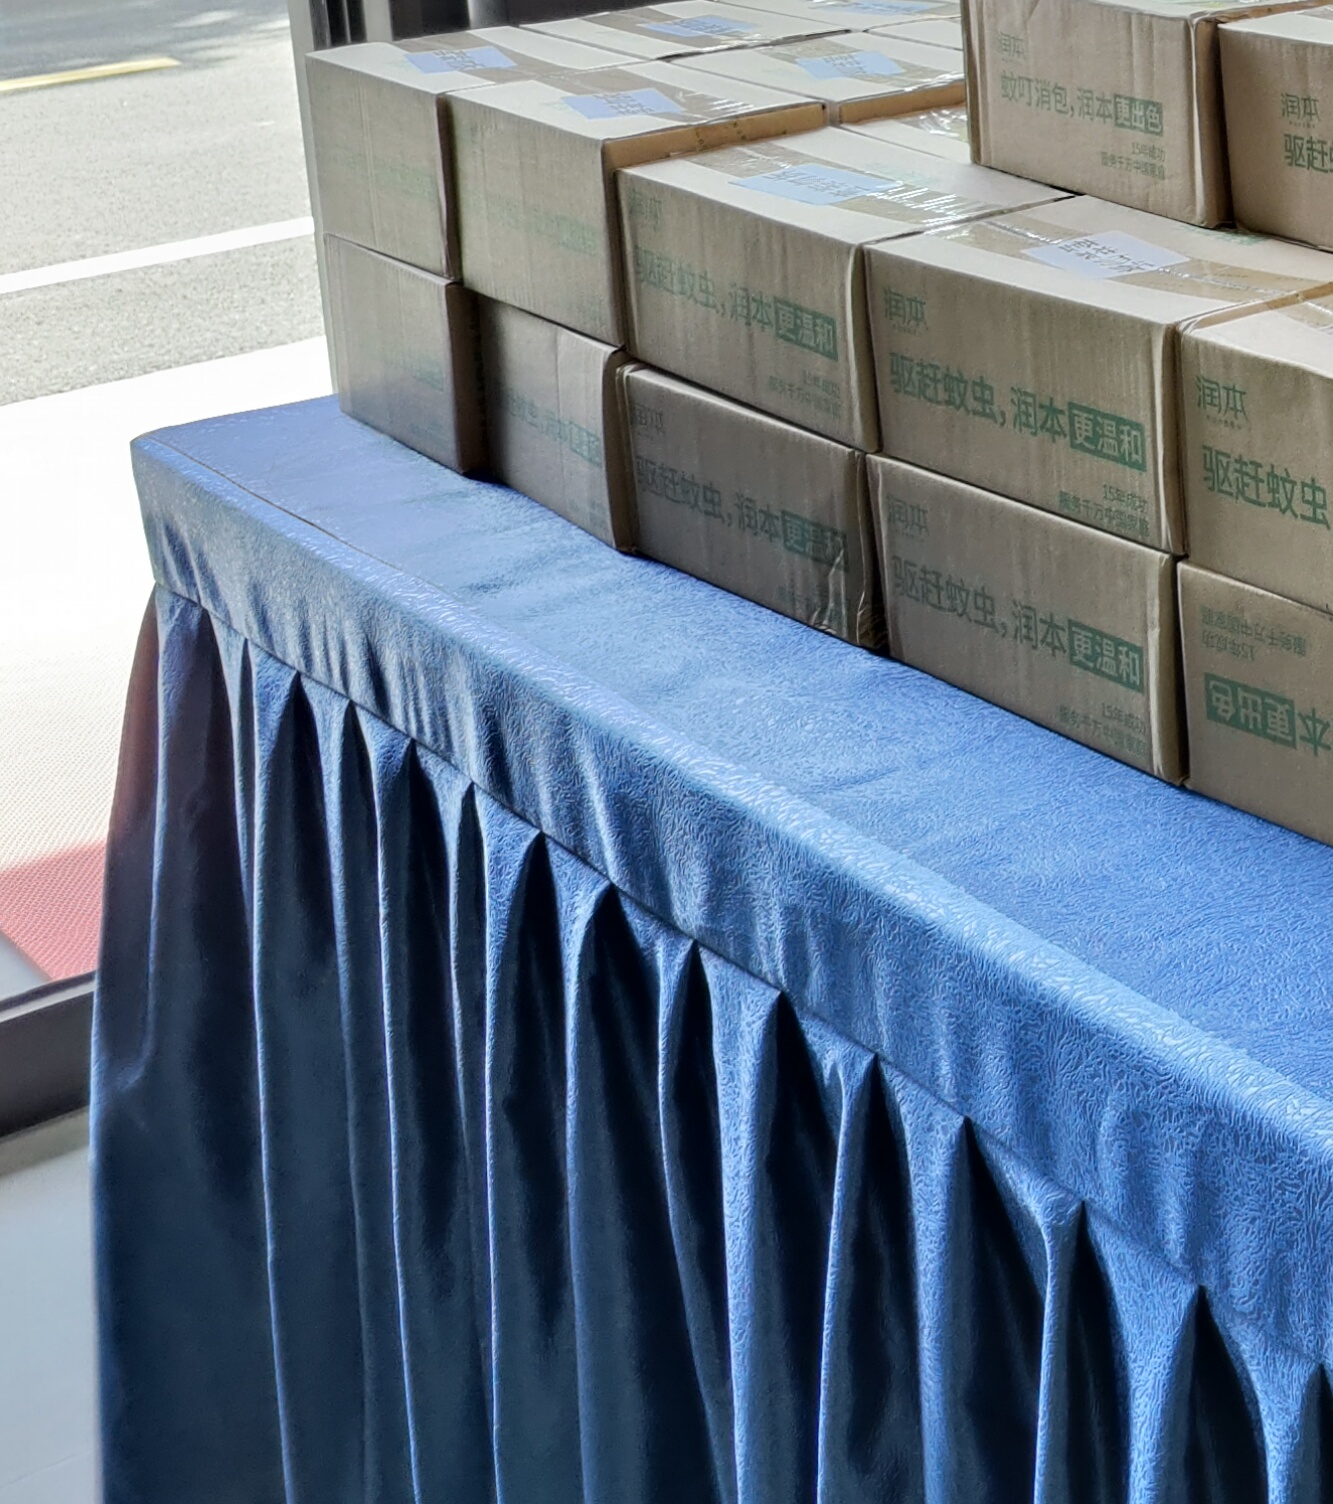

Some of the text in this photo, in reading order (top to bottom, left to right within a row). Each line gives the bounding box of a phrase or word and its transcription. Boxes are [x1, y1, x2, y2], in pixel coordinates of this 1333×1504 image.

[997, 33, 1026, 58] 润本
[1281, 93, 1320, 122] 润本
[884, 288, 926, 325] 润本
[889, 352, 1147, 472] 驱赶蚊虫，润本更温和
[1195, 376, 1248, 421] 润本
[887, 495, 929, 534] 润本
[891, 555, 1144, 695] 驱赶蚊虫，润本更温和
